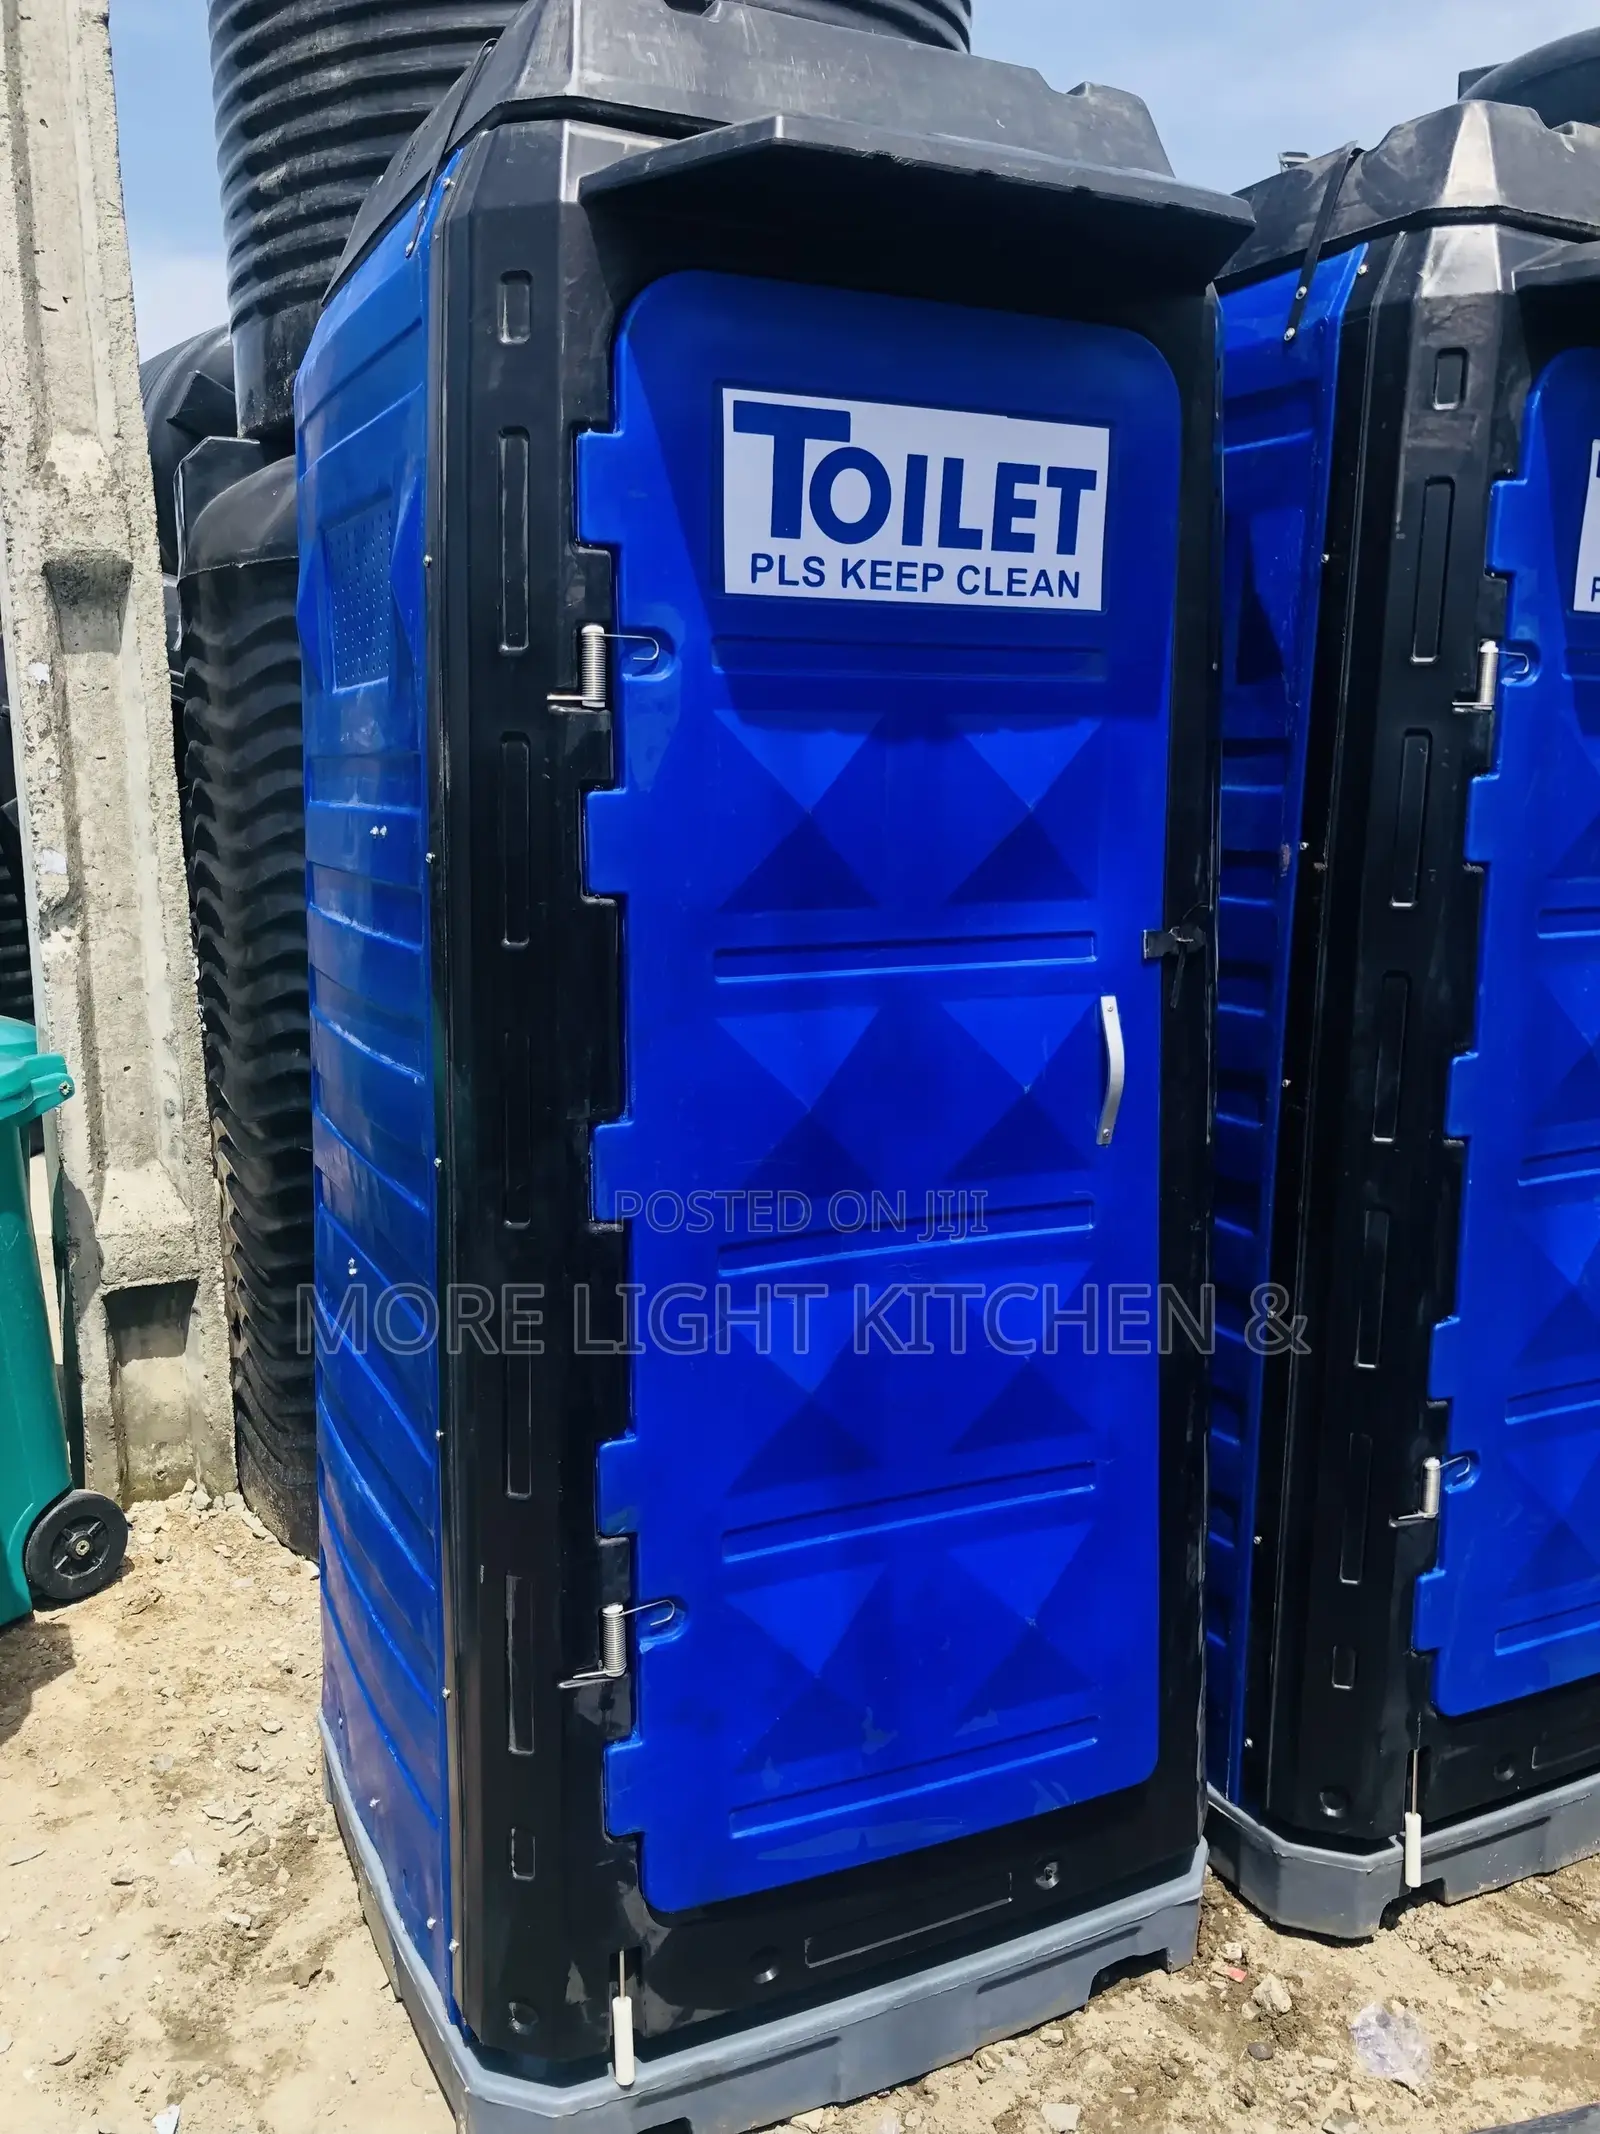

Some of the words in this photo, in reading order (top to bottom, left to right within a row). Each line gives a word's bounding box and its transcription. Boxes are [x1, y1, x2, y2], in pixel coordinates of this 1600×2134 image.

[732, 399, 1098, 556] TOILET
[750, 552, 826, 588] PLS
[840, 558, 944, 593] KEEP
[956, 564, 1080, 599] CLEAN
